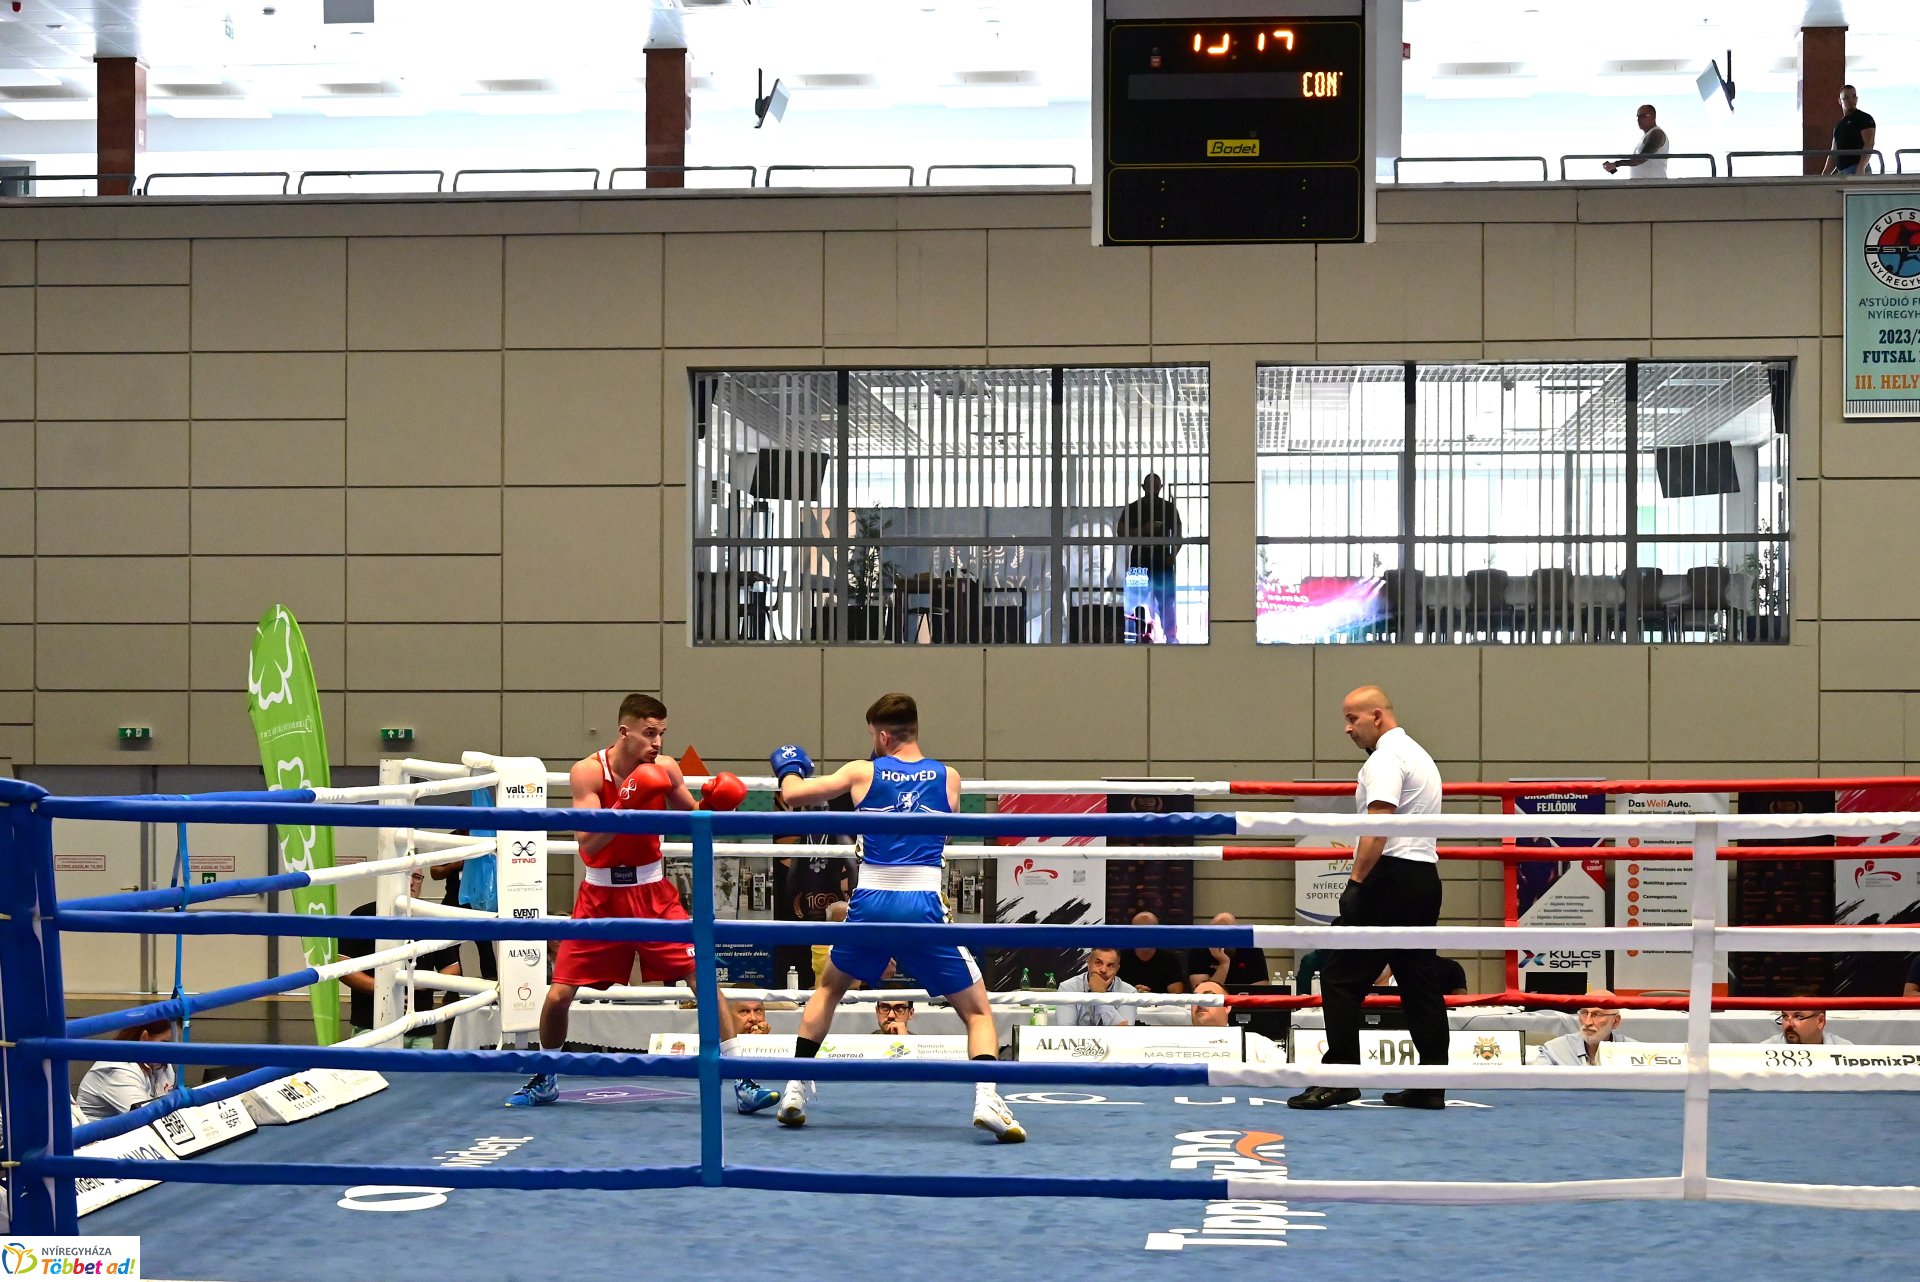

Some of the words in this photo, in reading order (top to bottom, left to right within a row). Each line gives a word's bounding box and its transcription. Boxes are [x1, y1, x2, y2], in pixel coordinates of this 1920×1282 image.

[1210, 141, 1257, 155] Bodet
[1874, 211, 1920, 233] FUTS
[1858, 295, 1910, 307] A'STÚDIÓ
[1862, 350, 1916, 364] FUTSAL
[1855, 374, 1876, 390] III.
[881, 769, 937, 782] HONVÉD
[1536, 801, 1577, 812] FEJLŐDIK
[1628, 799, 1645, 808] Das
[1646, 799, 1691, 808] WeltAuto.
[1313, 881, 1348, 890] NYÍREG
[1306, 892, 1342, 900] SPORTC
[1549, 950, 1602, 959] KULCS
[1549, 960, 1593, 969] SOFT
[1765, 1049, 1813, 1068] 383
